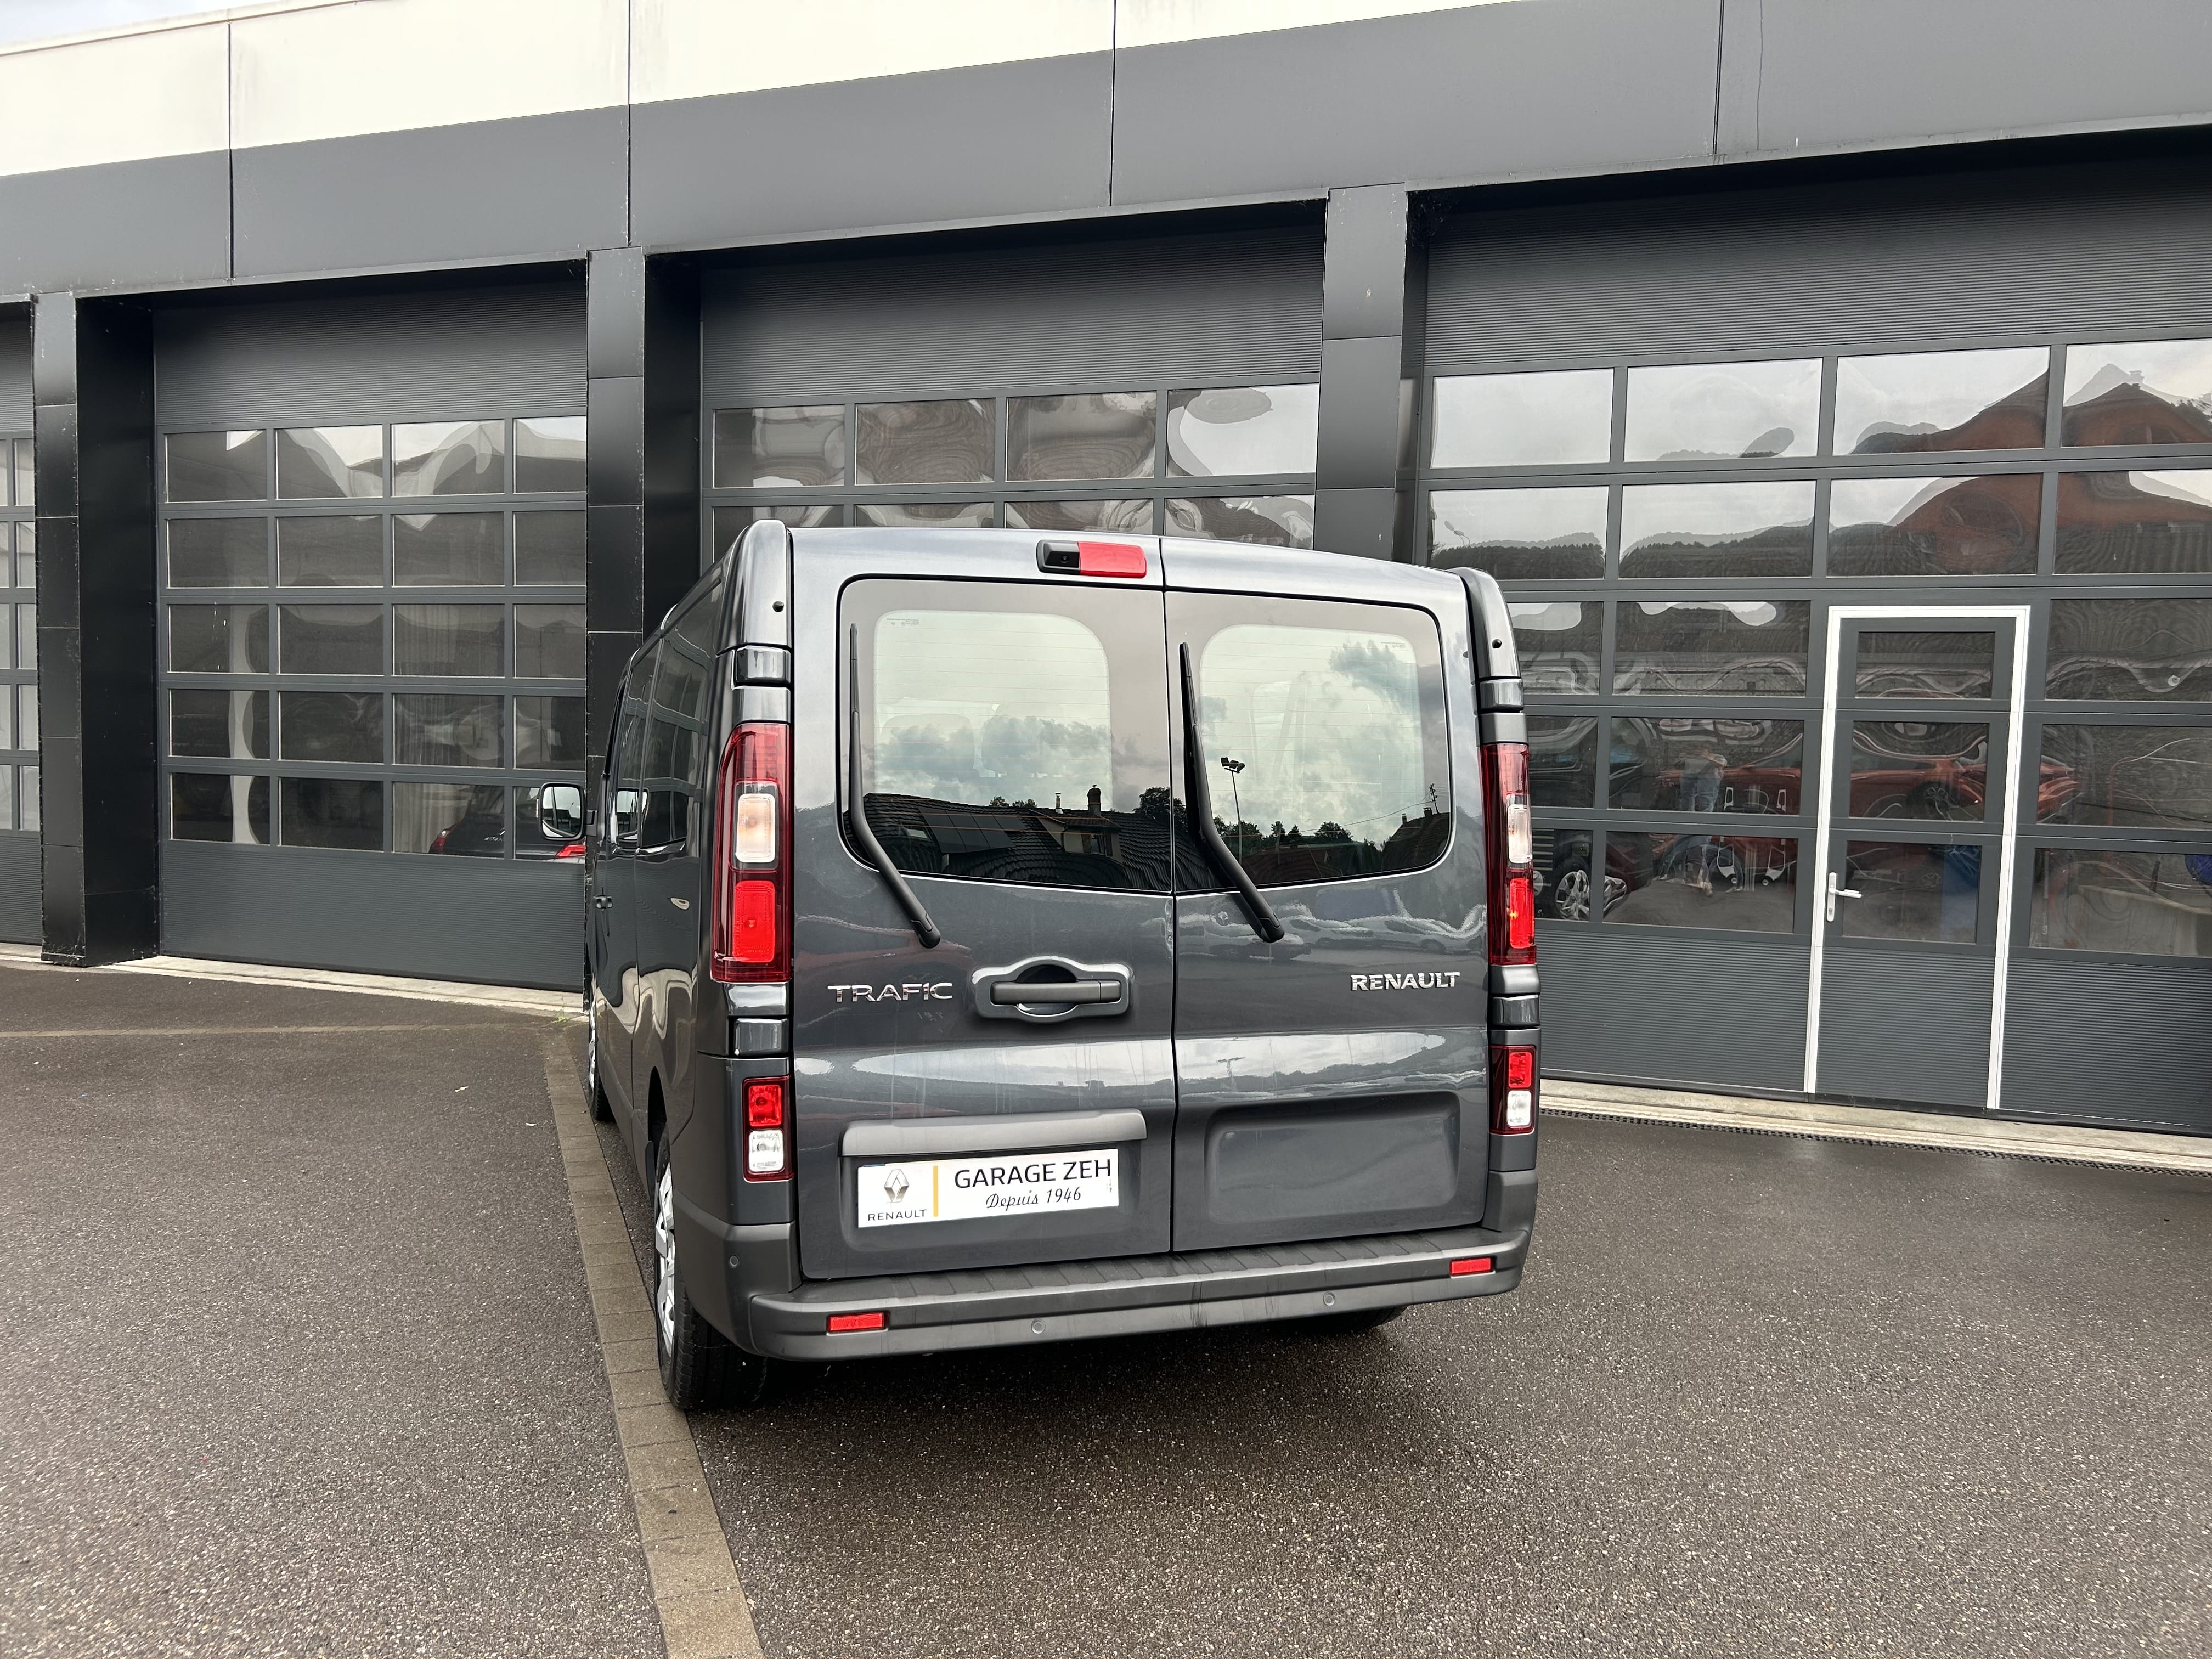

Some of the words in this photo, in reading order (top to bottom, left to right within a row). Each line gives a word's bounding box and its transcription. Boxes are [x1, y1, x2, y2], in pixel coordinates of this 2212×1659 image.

[1350, 972, 1460, 991] RENAULT
[827, 982, 953, 1002] TRAFIC
[955, 1163, 1056, 1188] GARAGE
[1063, 1159, 1110, 1180] ZEH
[985, 1190, 1039, 1211] Depuis
[1047, 1187, 1081, 1203] 1946
[868, 1209, 927, 1221] RENAULT
